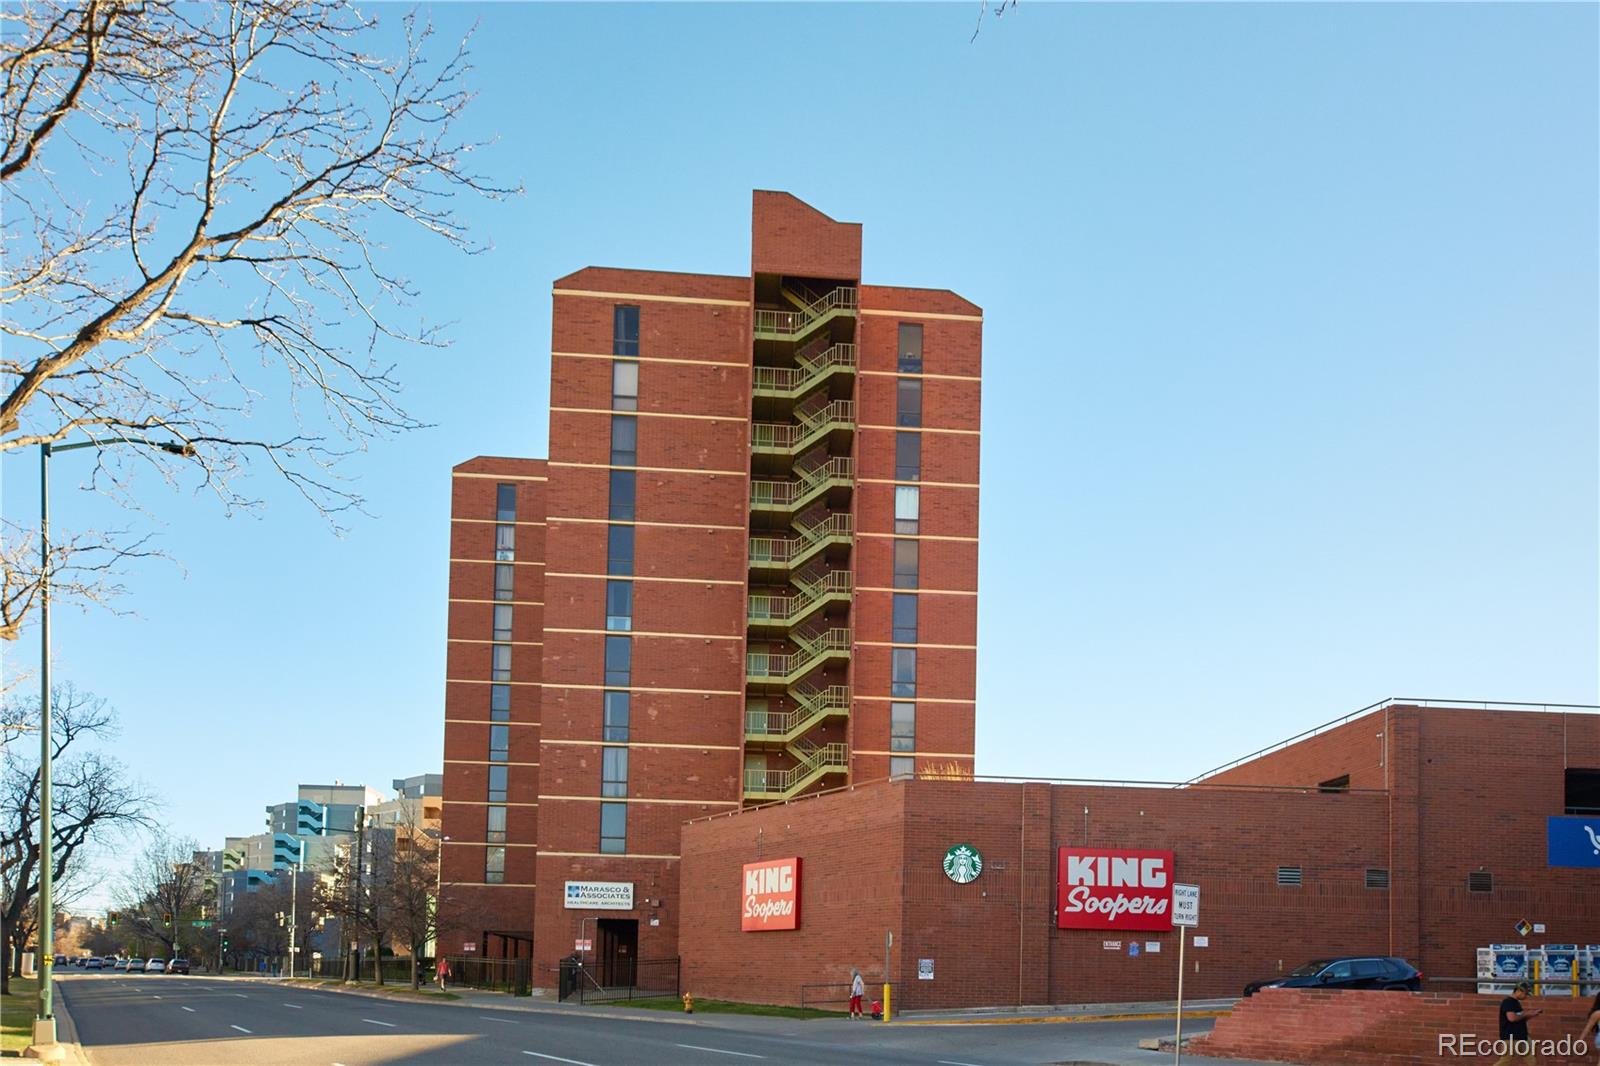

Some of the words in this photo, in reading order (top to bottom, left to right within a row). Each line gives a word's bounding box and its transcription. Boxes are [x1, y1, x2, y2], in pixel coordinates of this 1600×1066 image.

[745, 865, 793, 896] KING
[1067, 856, 1167, 888] KING
[580, 885, 621, 893] MARASCO
[1064, 886, 1168, 921] Soopers
[744, 895, 794, 923] Soopers
[1178, 901, 1193, 909] MUST
